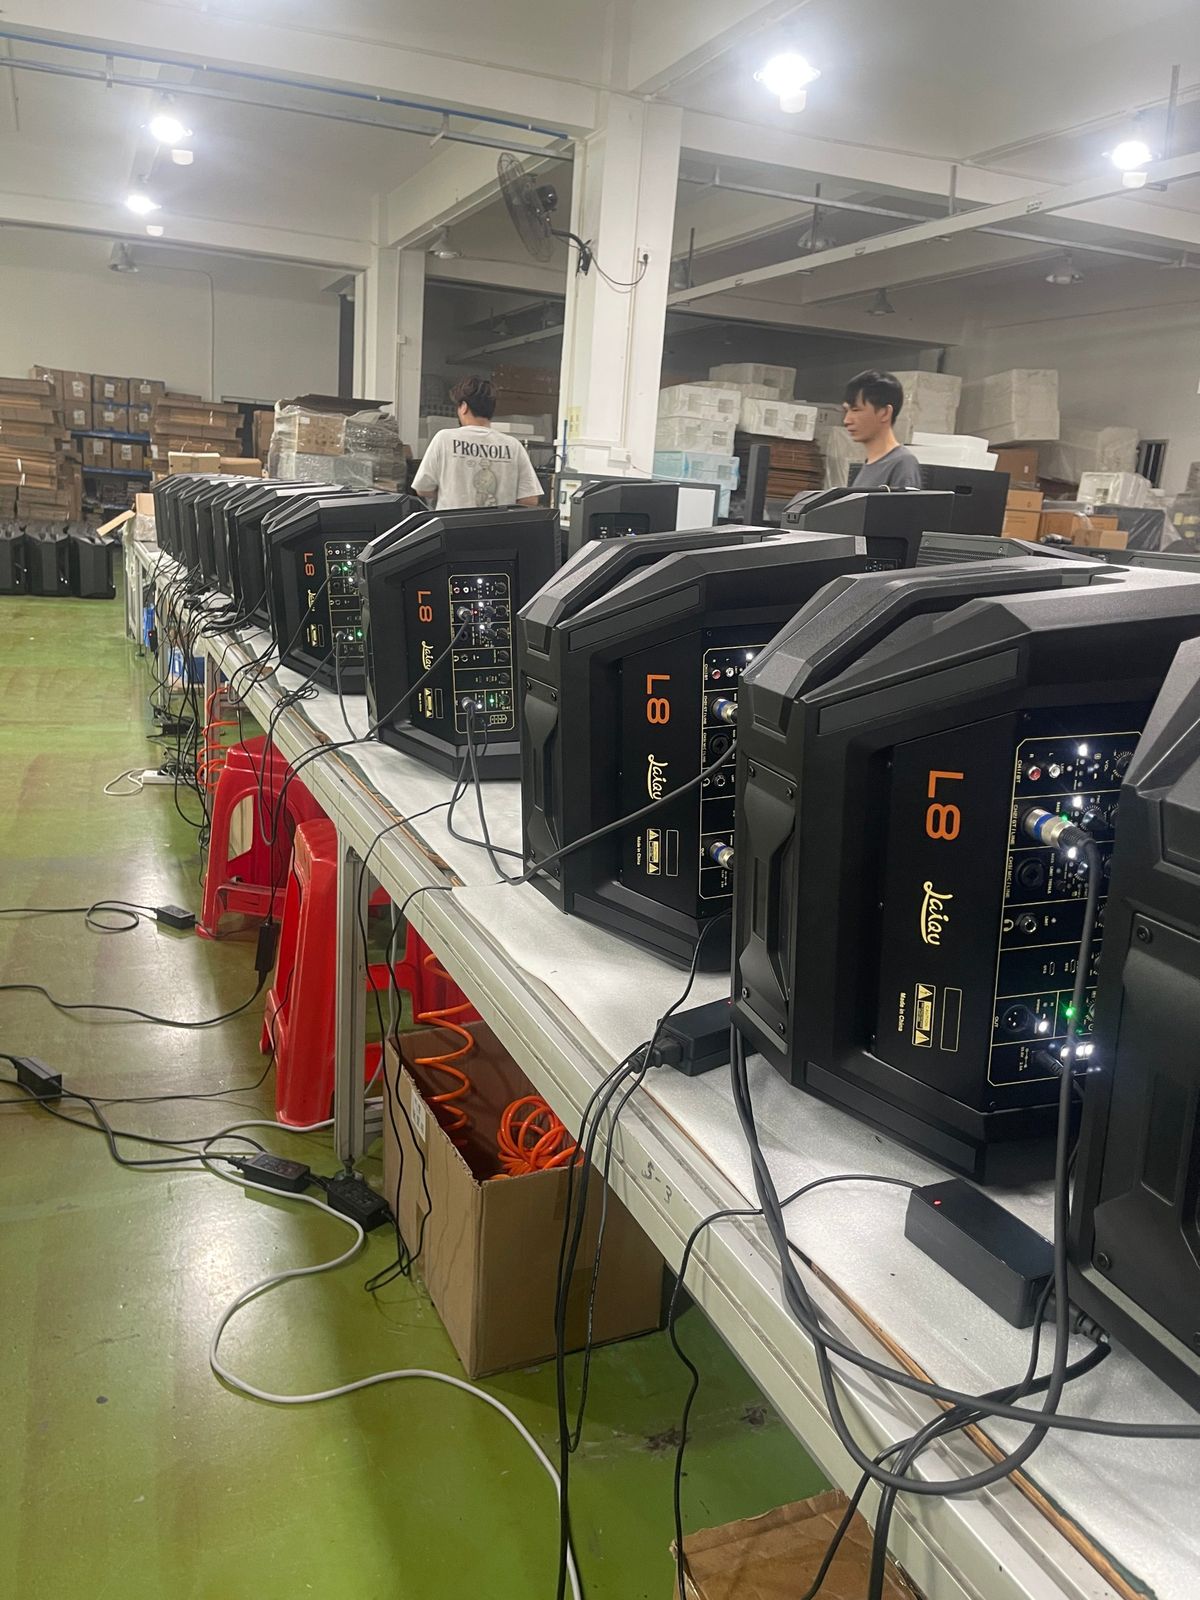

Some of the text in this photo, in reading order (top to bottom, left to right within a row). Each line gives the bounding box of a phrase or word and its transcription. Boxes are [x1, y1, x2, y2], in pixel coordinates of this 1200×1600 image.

[452, 439, 512, 460] PRONOIA
[304, 552, 315, 577] L8
[418, 590, 433, 623] L8
[647, 674, 671, 725] L8
[926, 770, 964, 842] L8
